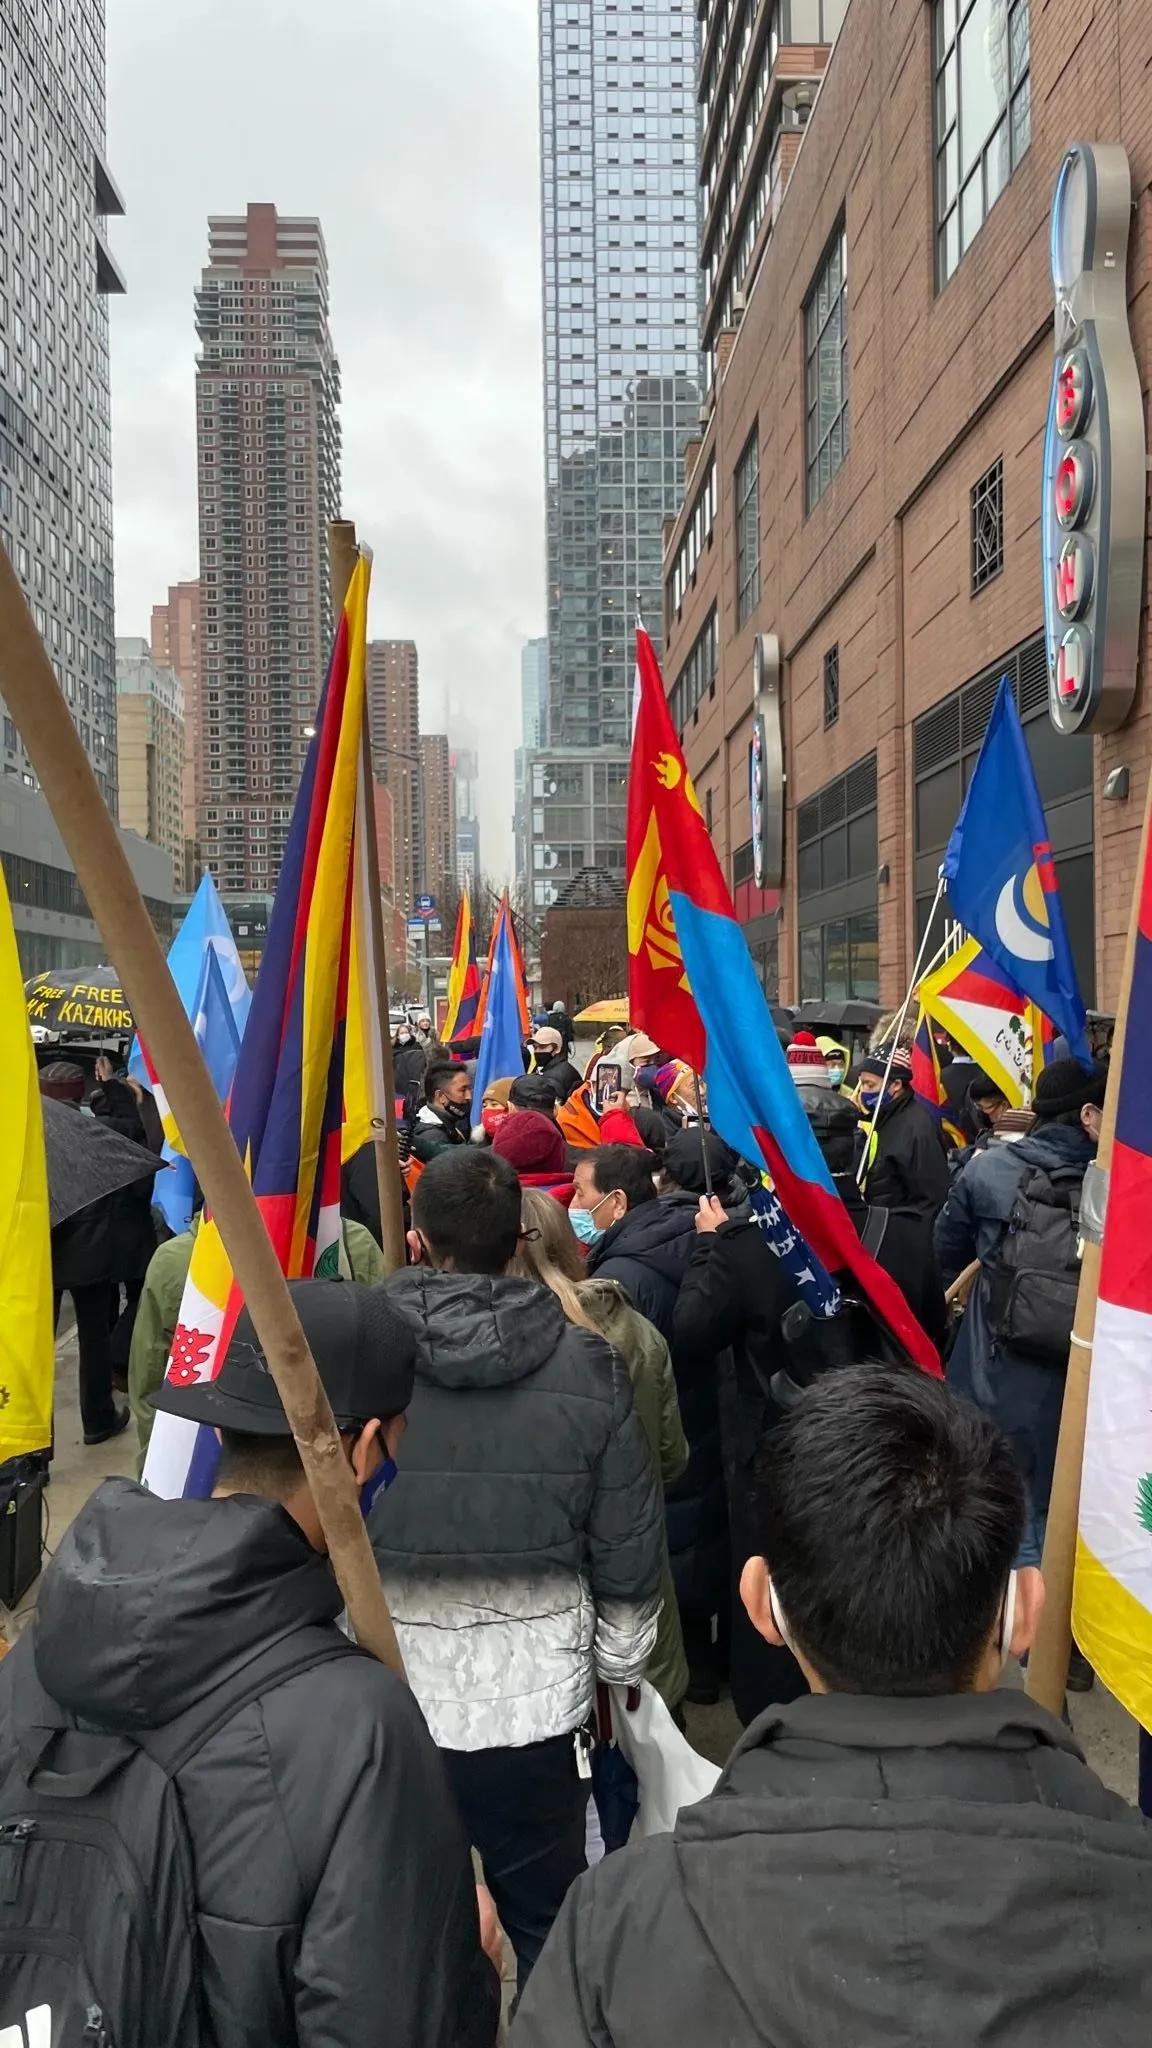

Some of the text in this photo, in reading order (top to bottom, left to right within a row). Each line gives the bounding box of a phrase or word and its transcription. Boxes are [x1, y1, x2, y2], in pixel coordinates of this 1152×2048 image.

[1055, 363, 1080, 697] BOWL
[32, 985, 66, 999] FREE
[71, 984, 124, 1004] FREE
[57, 1000, 133, 1028] KAZAKHS
[789, 1052, 822, 1063] RUTG
